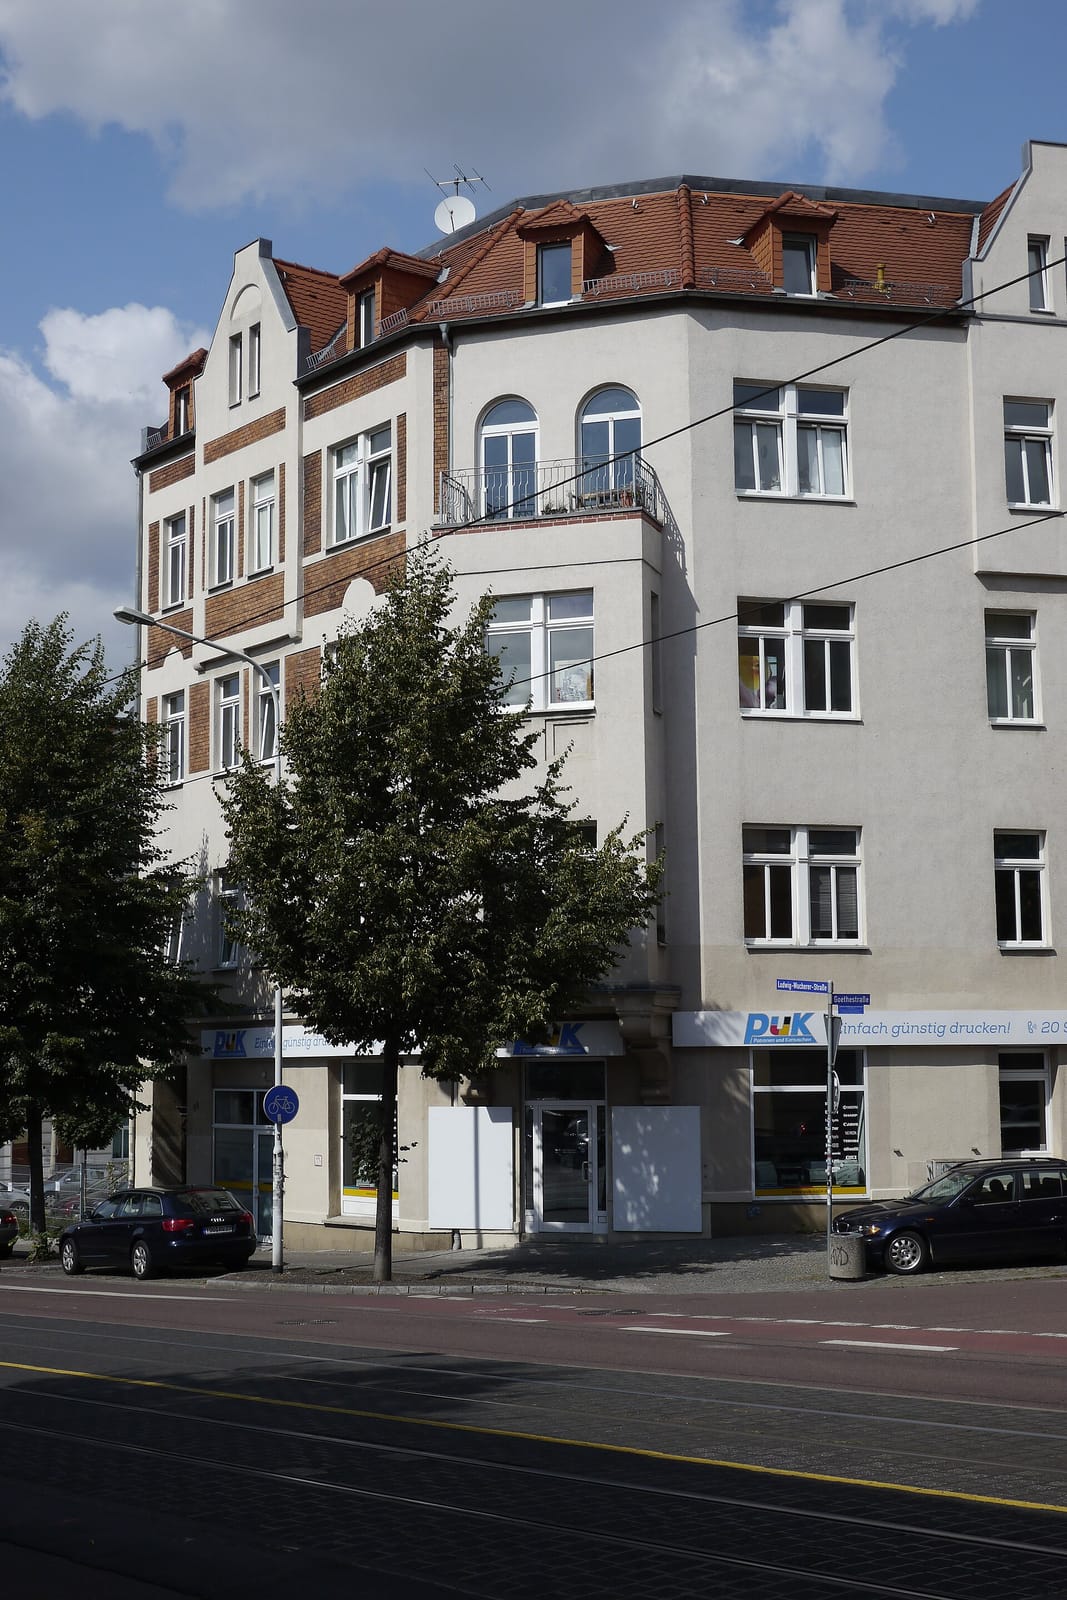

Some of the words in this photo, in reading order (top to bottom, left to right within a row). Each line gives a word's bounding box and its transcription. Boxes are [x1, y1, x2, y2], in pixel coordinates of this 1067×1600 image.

[833, 995, 869, 1003] Goethestraße
[840, 1022, 888, 1034] infach
[891, 1021, 946, 1037] günstig
[949, 1021, 1011, 1034] drucken!
[1040, 1021, 1060, 1034] 20
